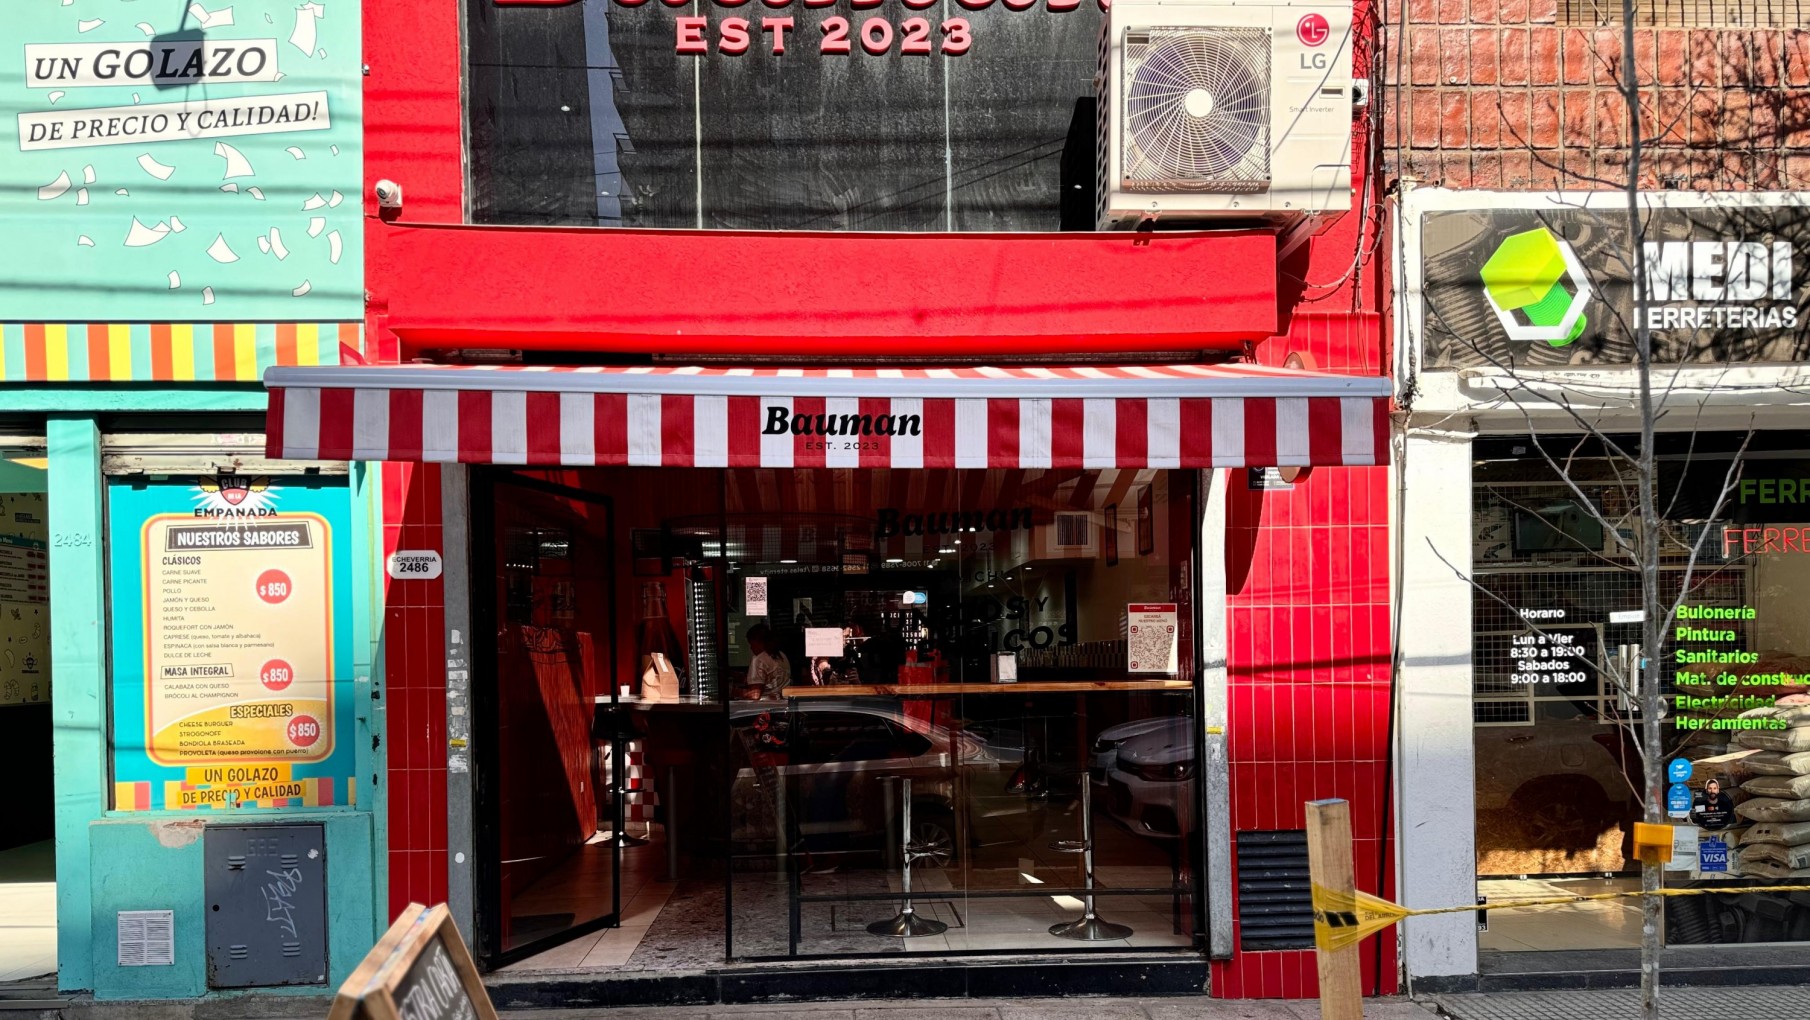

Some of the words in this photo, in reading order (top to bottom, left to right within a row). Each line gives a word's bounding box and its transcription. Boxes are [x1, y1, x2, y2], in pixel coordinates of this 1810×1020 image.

[675, 16, 794, 56] EST
[820, 16, 972, 56] 2023
[34, 57, 82, 80] UN
[93, 47, 268, 79] GOLAZO
[1300, 52, 1326, 70] LG
[28, 122, 64, 142] DE
[70, 114, 168, 140] PRECIO
[176, 112, 192, 131] Y
[197, 101, 320, 130] CALIDAD!
[1634, 242, 1792, 300] MEDI
[762, 406, 921, 436] Bauman
[805, 442, 838, 450] EST.
[844, 442, 880, 450] 2023
[222, 478, 247, 489] CLUB
[194, 508, 278, 517] EMPANADA
[876, 507, 1033, 538] Bauman
[54, 532, 92, 548] 2484
[178, 531, 240, 546] NUESTROS
[243, 530, 299, 546] SABORES
[962, 542, 998, 552] 2023
[162, 554, 201, 566] CLÁSICOS
[400, 563, 429, 572] 2486
[1520, 608, 1565, 618] Horario
[1676, 605, 1756, 620] Bulonería
[1512, 634, 1535, 644] Lun
[1538, 636, 1546, 644] a
[1548, 633, 1574, 644] Vier
[1676, 627, 1736, 642] Pintura
[1510, 647, 1537, 658] 8:30
[1541, 649, 1548, 657] a
[1551, 646, 1585, 657] 19:00
[1676, 649, 1759, 664] Sanitarios
[165, 668, 188, 676] MASA
[190, 666, 229, 676] INTEGRAL
[1518, 659, 1570, 670] Sabados
[1511, 673, 1539, 684] 9:00
[1542, 675, 1550, 683] a
[1552, 672, 1586, 683] 18:00
[1676, 672, 1711, 685] Mat.
[1716, 671, 1737, 685] de
[1676, 695, 1776, 709] Electricidad
[230, 704, 293, 718] ESPECIALES
[1676, 716, 1787, 730] Herramientas
[204, 768, 222, 782] UN
[228, 767, 278, 782] GOLAZO
[183, 792, 196, 804] DE
[244, 788, 251, 799] Y
[254, 784, 301, 798] CALIDAD
[1702, 854, 1726, 863] VISA
